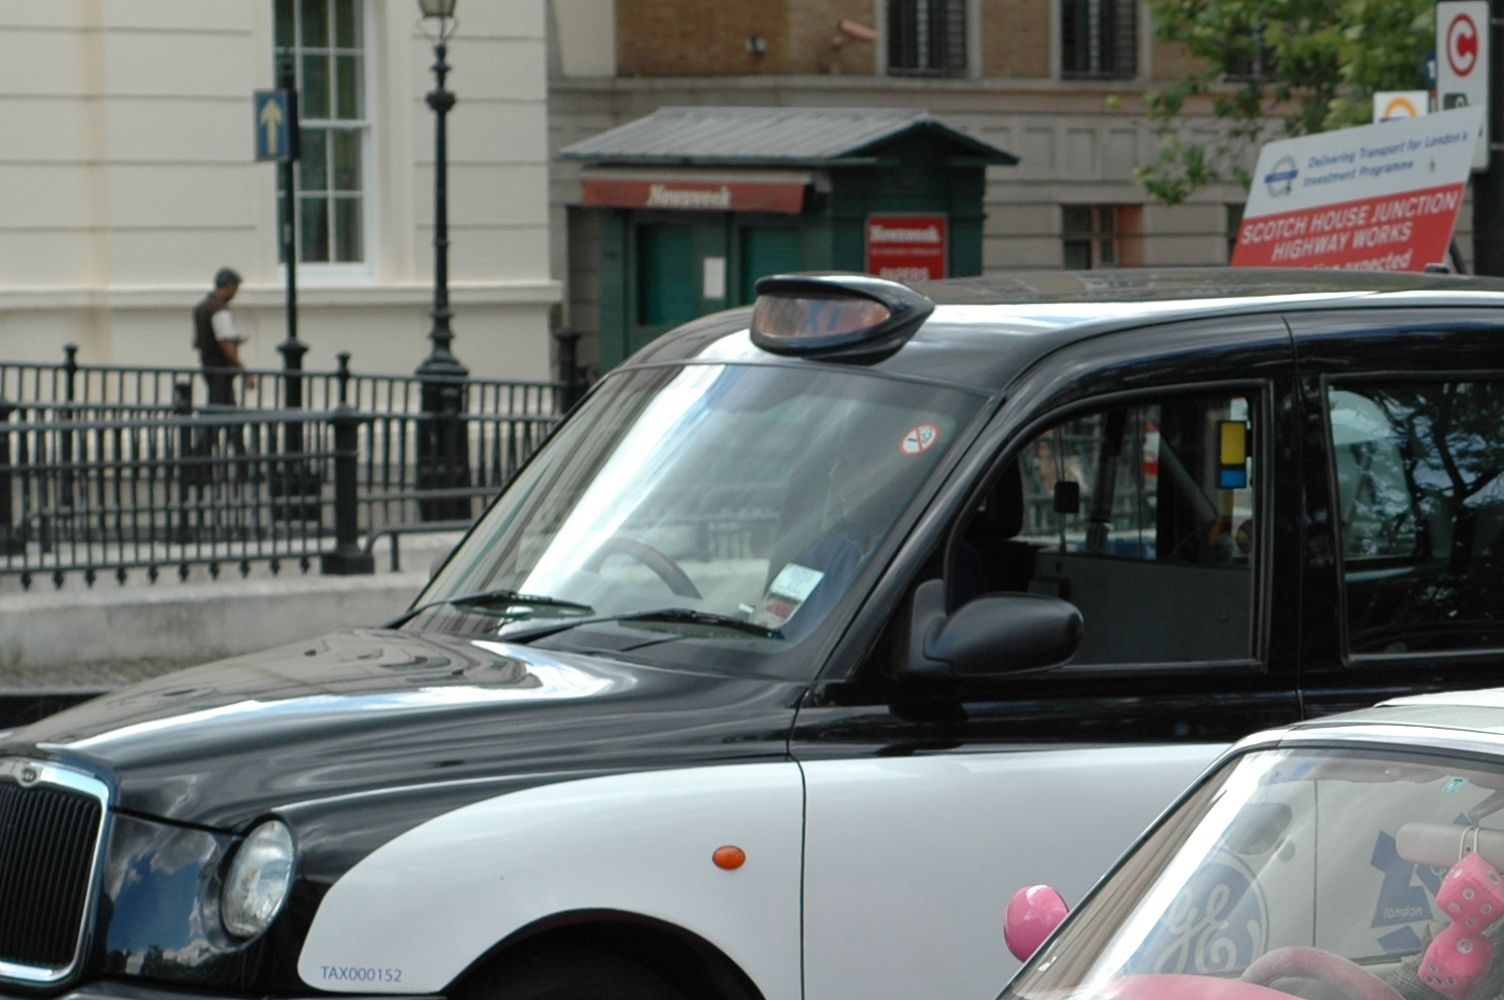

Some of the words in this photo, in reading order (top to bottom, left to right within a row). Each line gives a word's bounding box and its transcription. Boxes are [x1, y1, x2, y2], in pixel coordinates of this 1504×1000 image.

[1307, 147, 1356, 169] Delivering
[1358, 140, 1406, 163] Transport
[1407, 136, 1423, 153] for
[1302, 169, 1358, 189] Investment
[1358, 158, 1415, 182] Programme
[646, 184, 732, 208] Newsweek
[1241, 216, 1306, 246] SCOTCH
[1310, 206, 1368, 232] HOUSE
[1369, 191, 1459, 223] JUNCTION
[869, 224, 941, 243] Newsweek
[1271, 230, 1349, 262] HIGHWAY
[1351, 219, 1413, 249] WORKS
[1382, 901, 1425, 920] london
[320, 965, 403, 983] TAX000152
